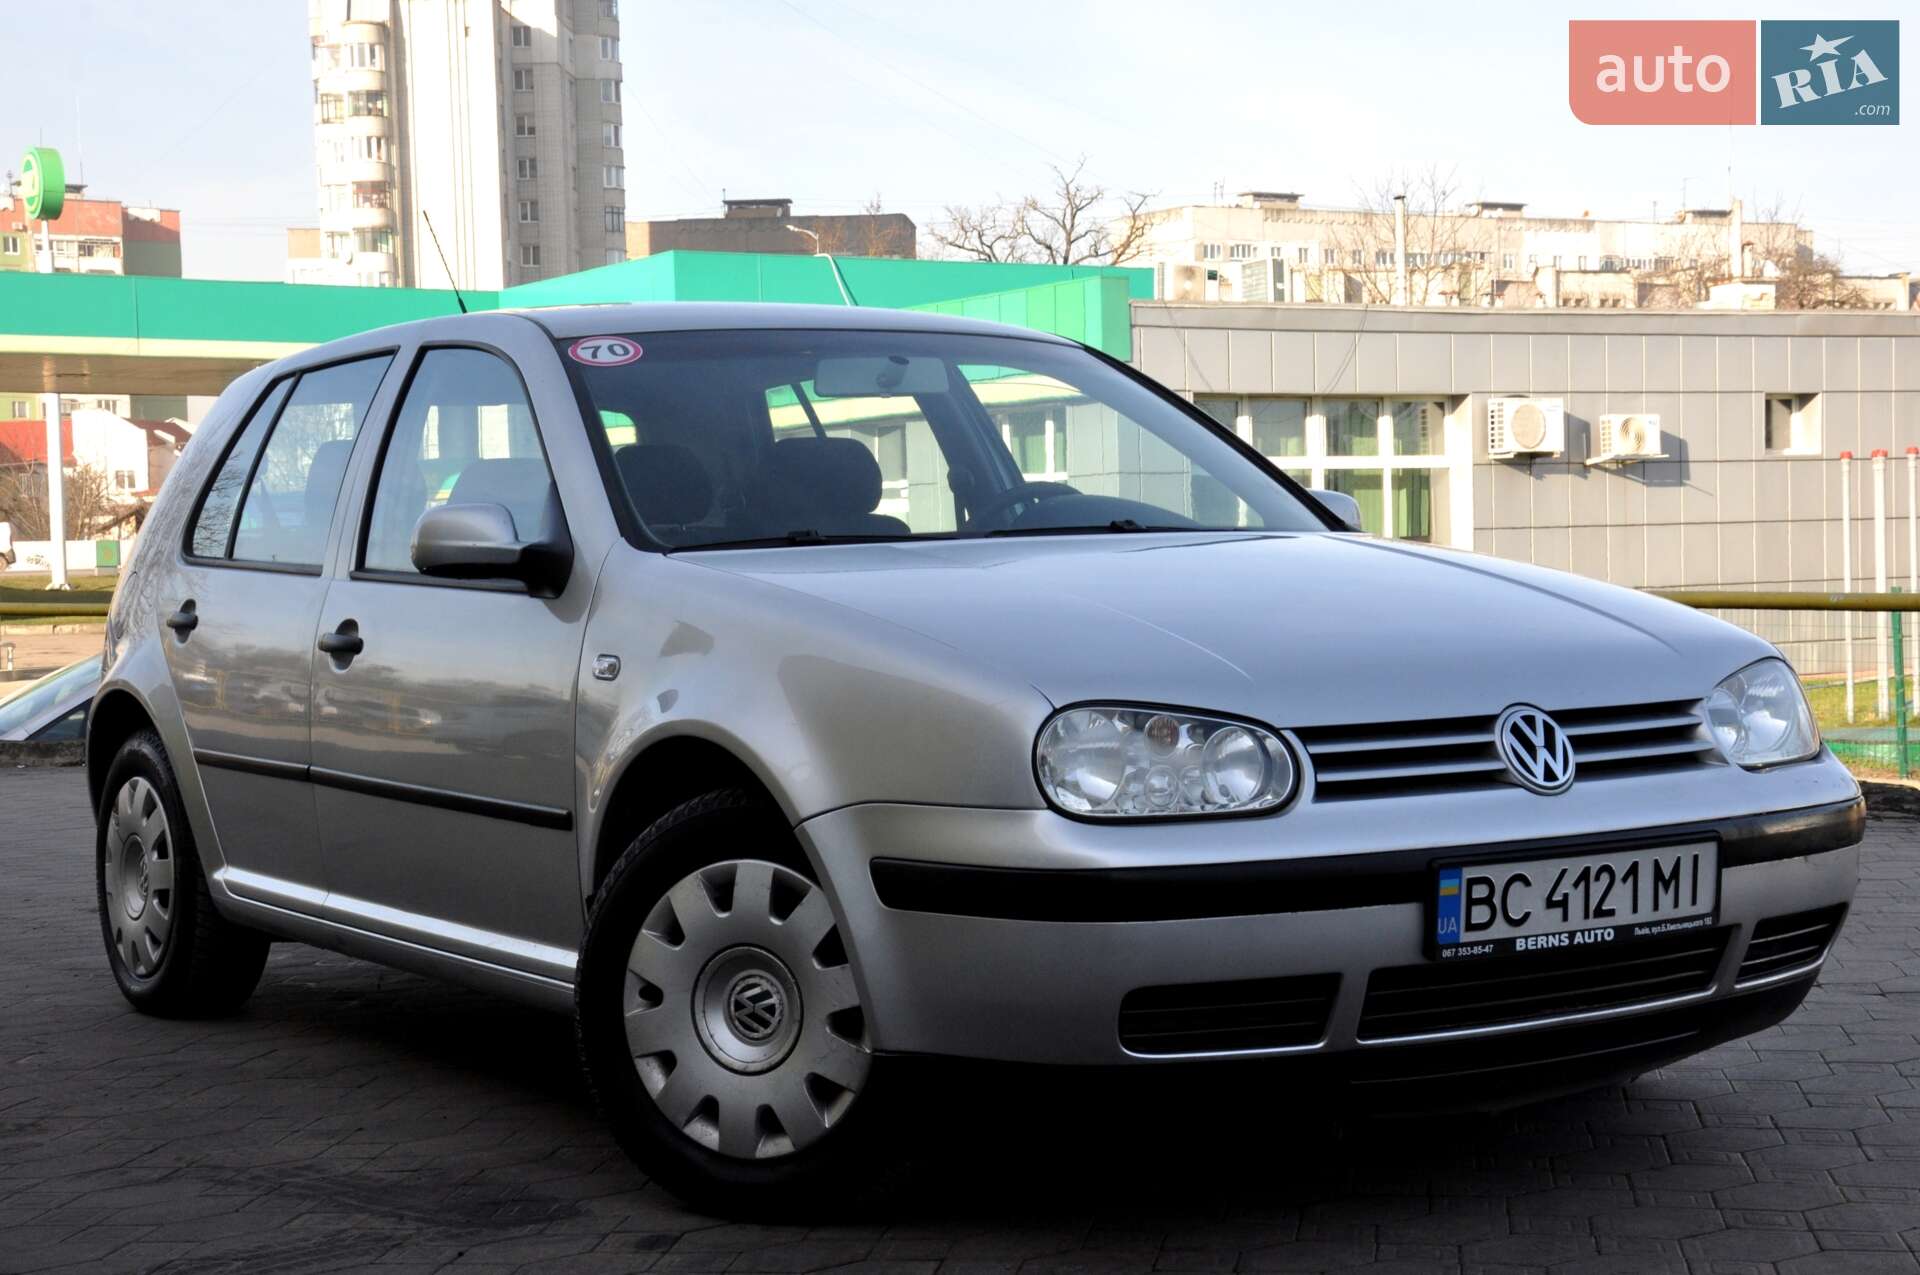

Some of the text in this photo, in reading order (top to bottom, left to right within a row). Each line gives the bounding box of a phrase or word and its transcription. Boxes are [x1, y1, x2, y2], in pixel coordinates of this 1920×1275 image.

[580, 343, 631, 360] 70
[1465, 853, 1699, 932] BC 4121 MI
[1438, 917, 1458, 934] UA
[1516, 927, 1615, 951] BERNS AUTO
[1442, 947, 1456, 958] 067
